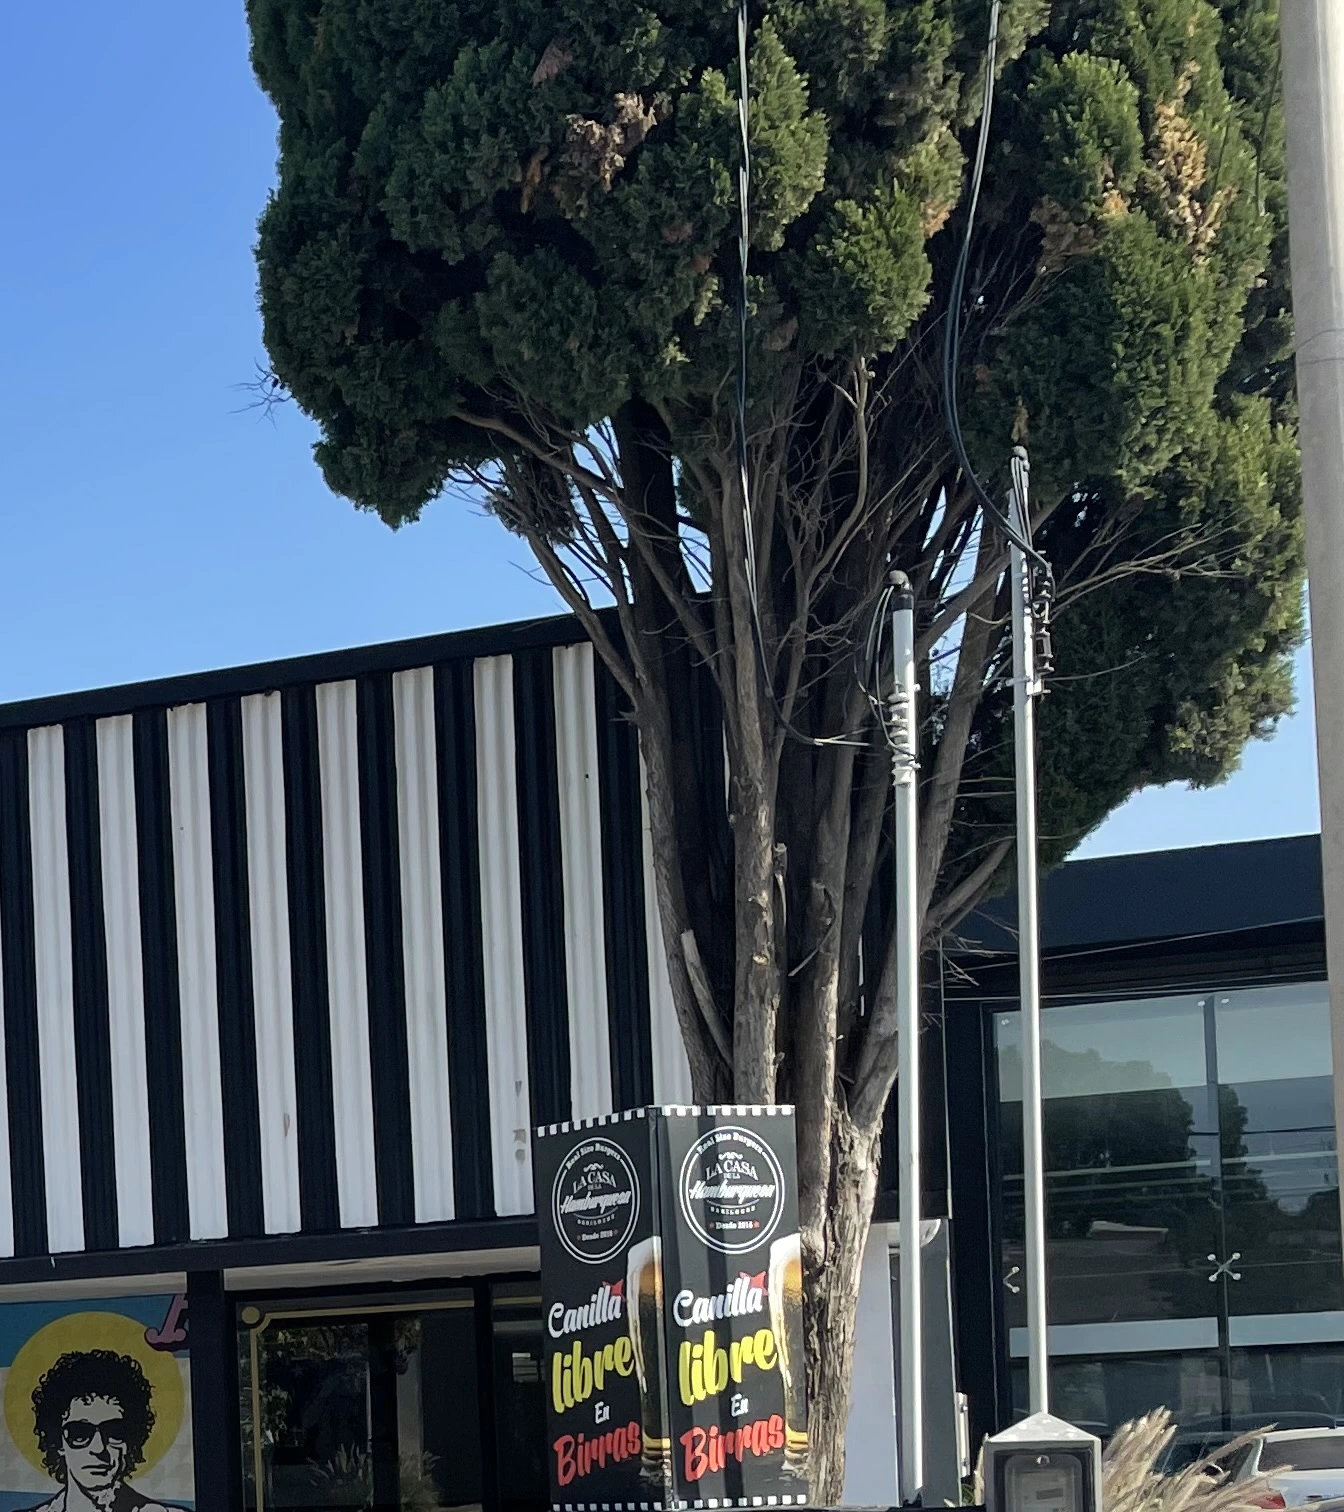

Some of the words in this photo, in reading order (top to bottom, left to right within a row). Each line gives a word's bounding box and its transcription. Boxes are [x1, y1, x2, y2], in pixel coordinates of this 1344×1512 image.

[573, 1176, 587, 1194] LA
[587, 1171, 617, 1188] CASA
[706, 1163, 723, 1180] LA
[723, 1160, 759, 1181] CASA
[548, 1285, 622, 1339] Canilla
[672, 1276, 763, 1328] Canilla
[552, 1336, 635, 1414] libre
[678, 1329, 779, 1407] libre
[594, 1401, 610, 1424] En
[730, 1393, 749, 1417] En
[553, 1421, 641, 1486] Birras
[679, 1414, 785, 1482] Birras
